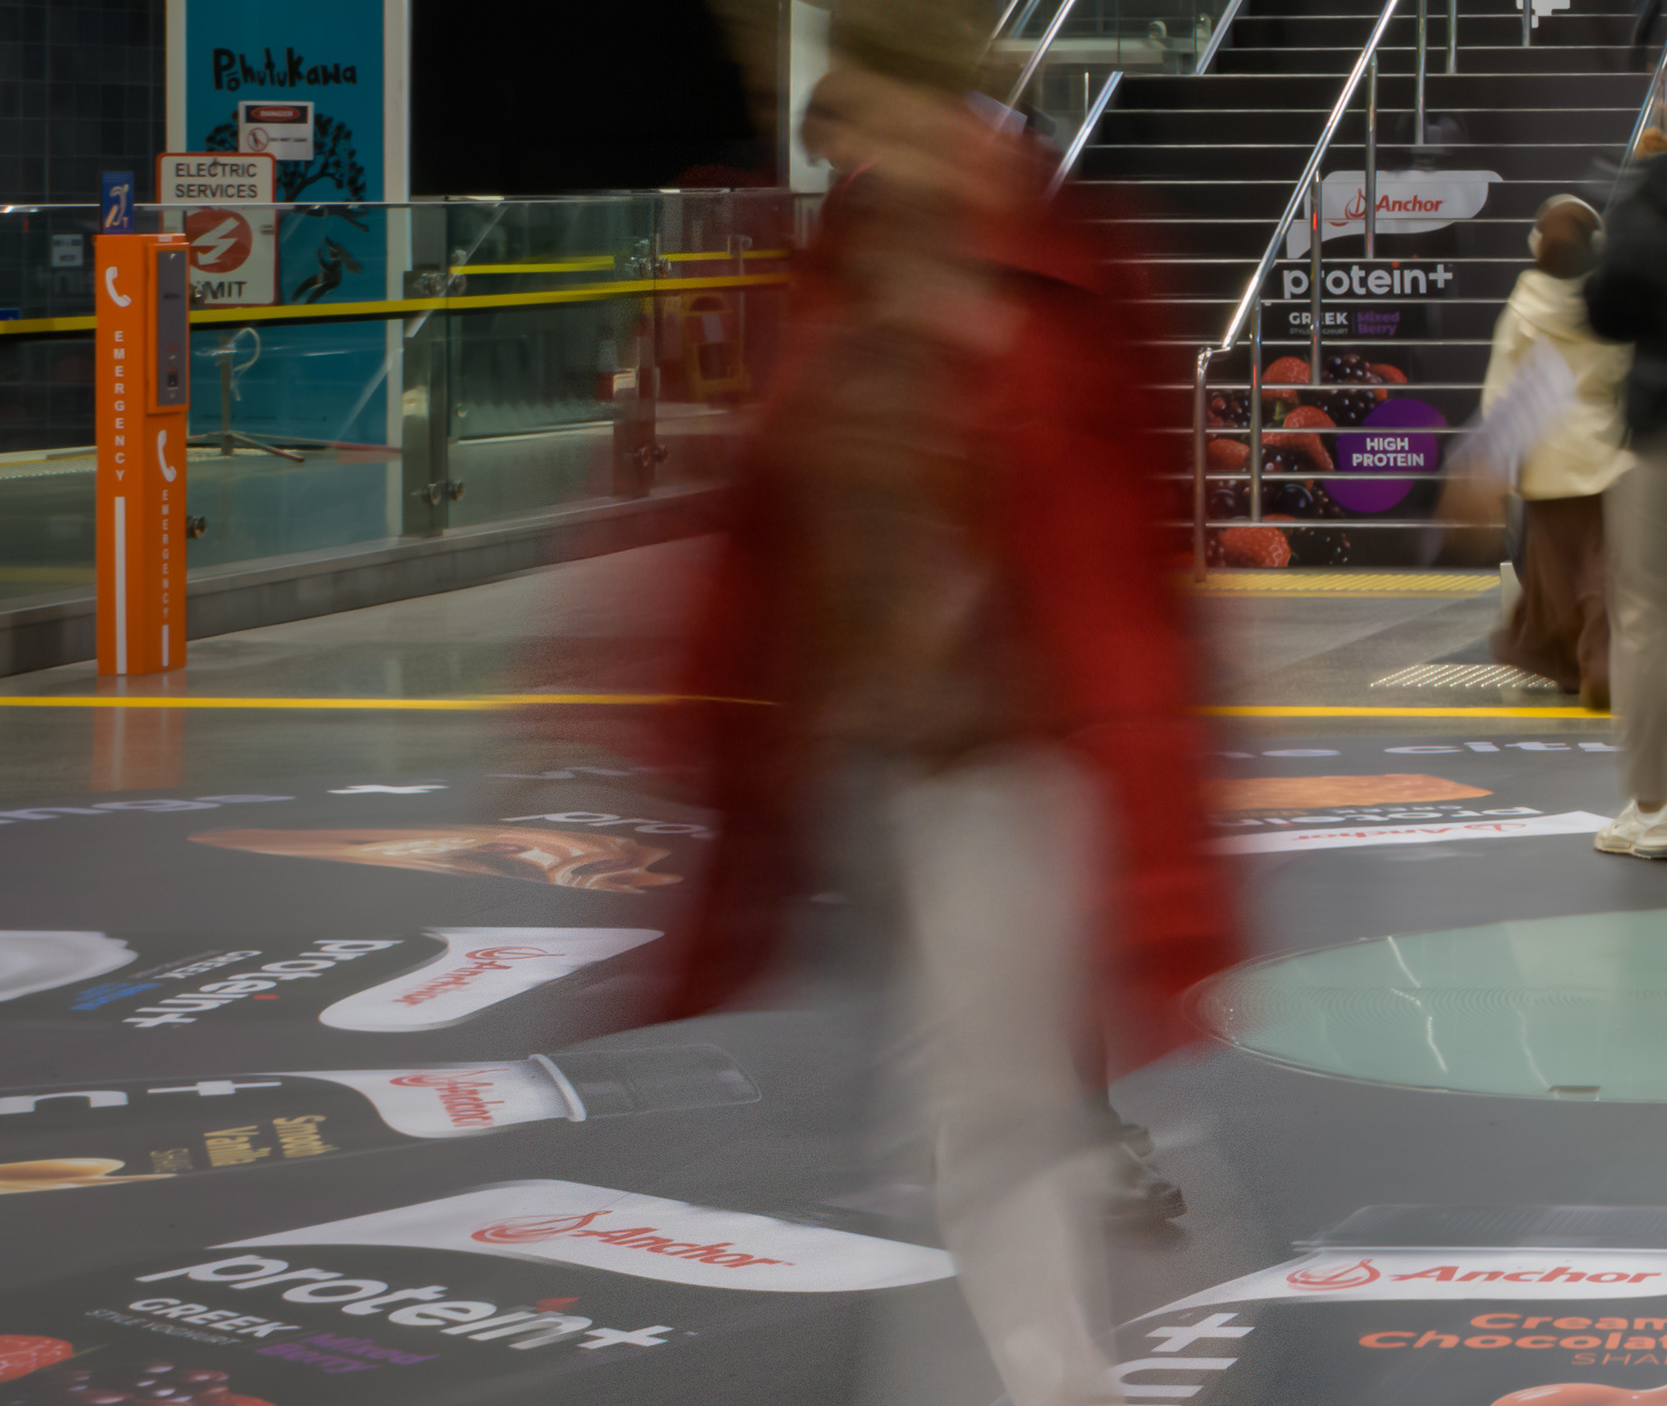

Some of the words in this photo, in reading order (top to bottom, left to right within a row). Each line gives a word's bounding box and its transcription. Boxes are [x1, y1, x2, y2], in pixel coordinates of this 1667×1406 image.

[175, 162, 257, 178] ELECTRIC
[175, 183, 258, 199] SERVICES
[1375, 196, 1444, 214] Anchor
[1282, 258, 1454, 300] potein+
[1288, 311, 1349, 325] GREK
[1357, 310, 1400, 323] Mixed
[1357, 323, 1397, 337] Berry
[112, 330, 127, 482] EMERGENCY
[1352, 452, 1425, 468] PROTEIN
[1365, 437, 1410, 451] HIGH
[161, 489, 170, 620] EMERGENCY
[154, 950, 263, 980] GREEK
[122, 939, 403, 1029] protein+
[202, 1125, 273, 1169] Vanilla
[271, 1115, 341, 1158] Smooth
[572, 1222, 790, 1272] Anchor
[1388, 1264, 1664, 1286] Anchor
[128, 1295, 302, 1342] GREEK
[134, 1252, 676, 1352] protein+
[255, 1342, 385, 1377] Berry
[308, 1331, 441, 1370] Mixed
